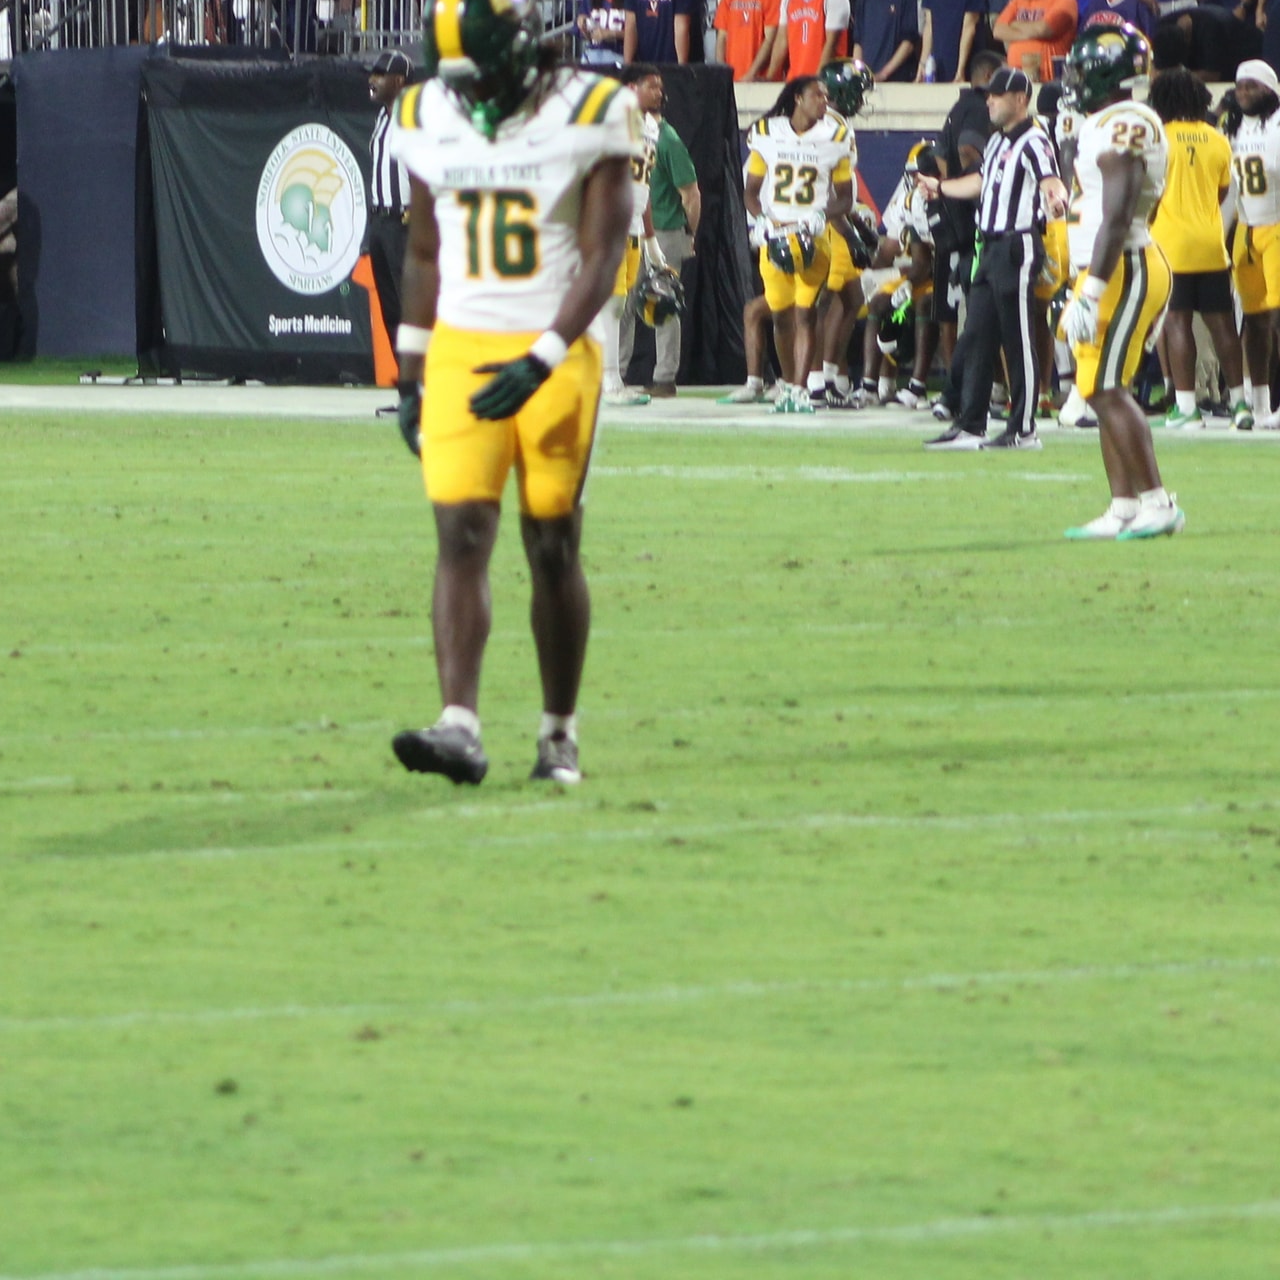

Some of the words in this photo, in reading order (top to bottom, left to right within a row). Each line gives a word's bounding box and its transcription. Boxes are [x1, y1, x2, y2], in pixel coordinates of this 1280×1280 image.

[801, 20, 808, 45] 1
[1063, 116, 1073, 133] 9
[1111, 121, 1147, 151] 22
[259, 144, 289, 209] NORFOLK
[290, 126, 321, 145] STATE
[326, 130, 366, 208] UNIVERSITY
[1186, 146, 1196, 167] 7
[502, 164, 544, 180] STATE
[773, 163, 818, 206] 23
[1234, 155, 1267, 197] 18
[455, 189, 540, 282] 16
[286, 272, 334, 291] SPARTANS
[268, 314, 303, 336] Sports
[304, 314, 352, 335] Medicine
